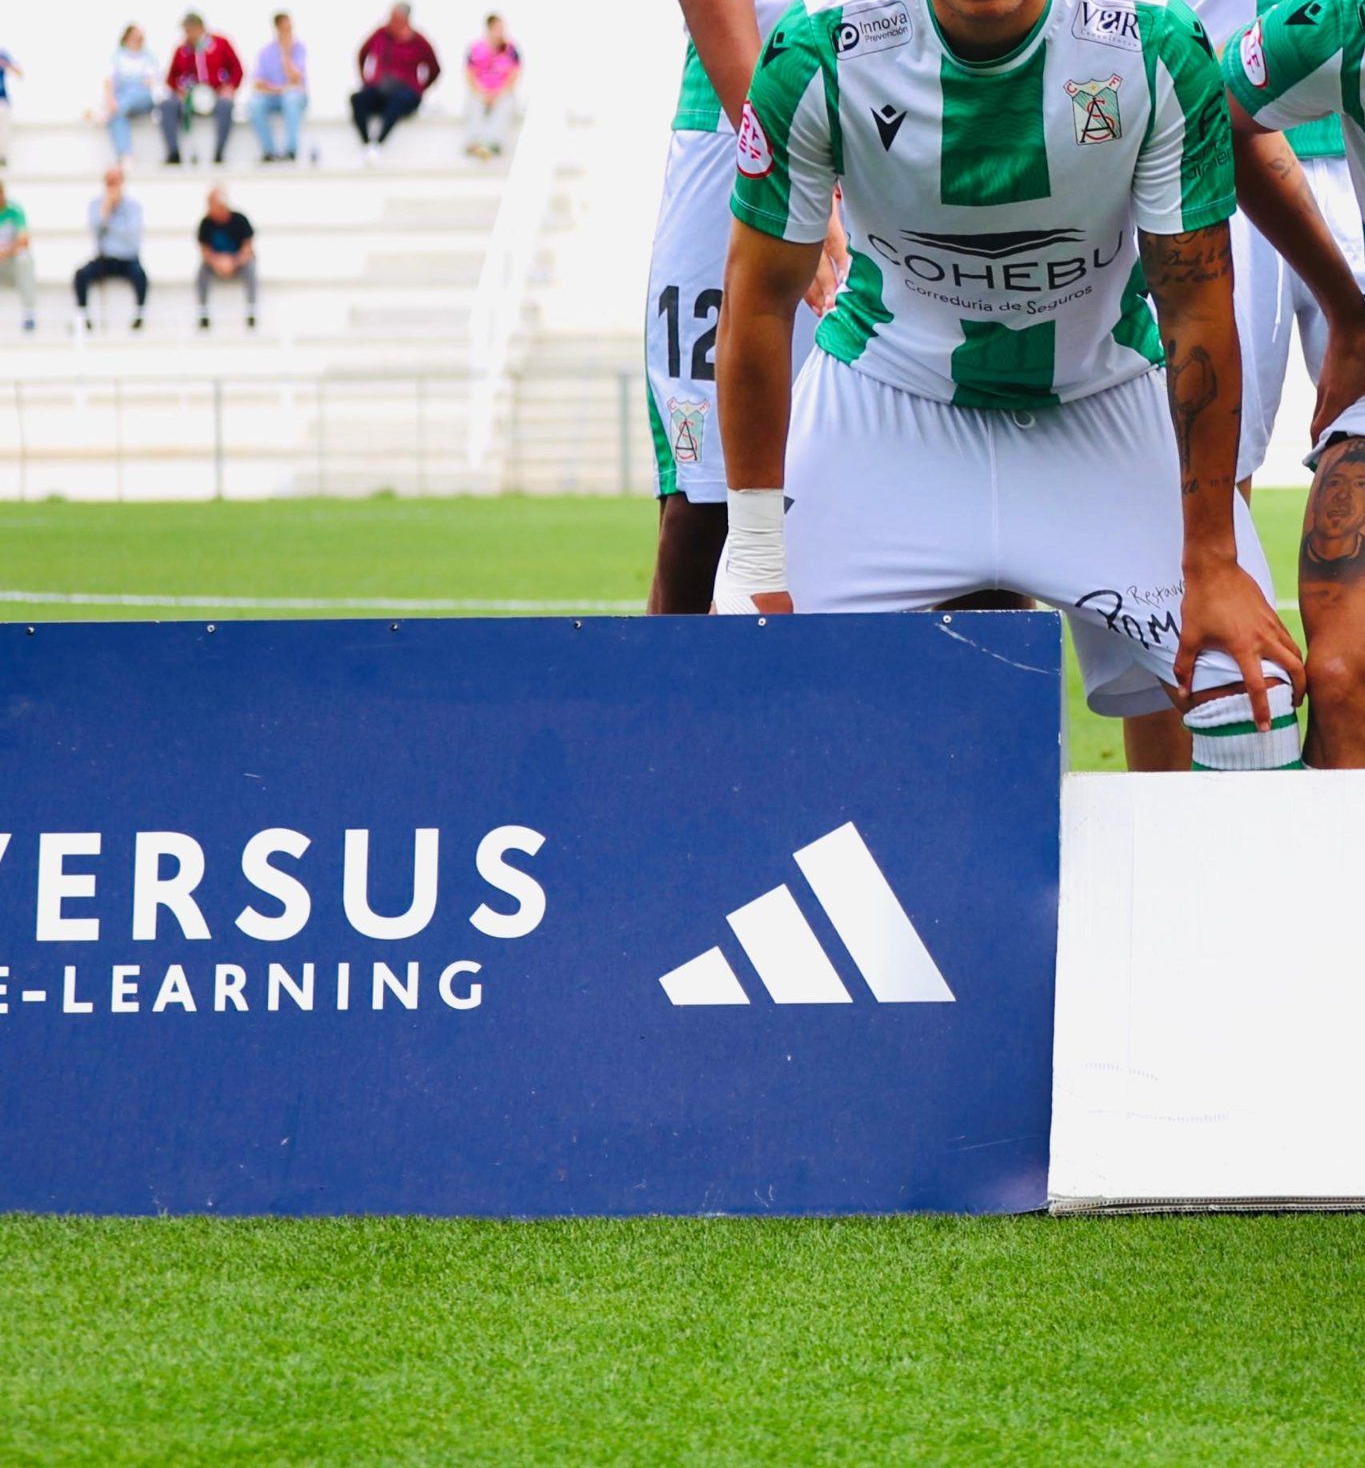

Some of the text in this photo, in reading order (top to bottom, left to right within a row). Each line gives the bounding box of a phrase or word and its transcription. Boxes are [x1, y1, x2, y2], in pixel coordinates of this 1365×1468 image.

[859, 12, 908, 35] Innova
[1082, 1, 1139, 40] V&R
[868, 230, 1123, 292] COHEBU
[904, 278, 1093, 315] Correduría de Seguros
[658, 285, 723, 381] 12
[0, 824, 547, 944] ERSUS
